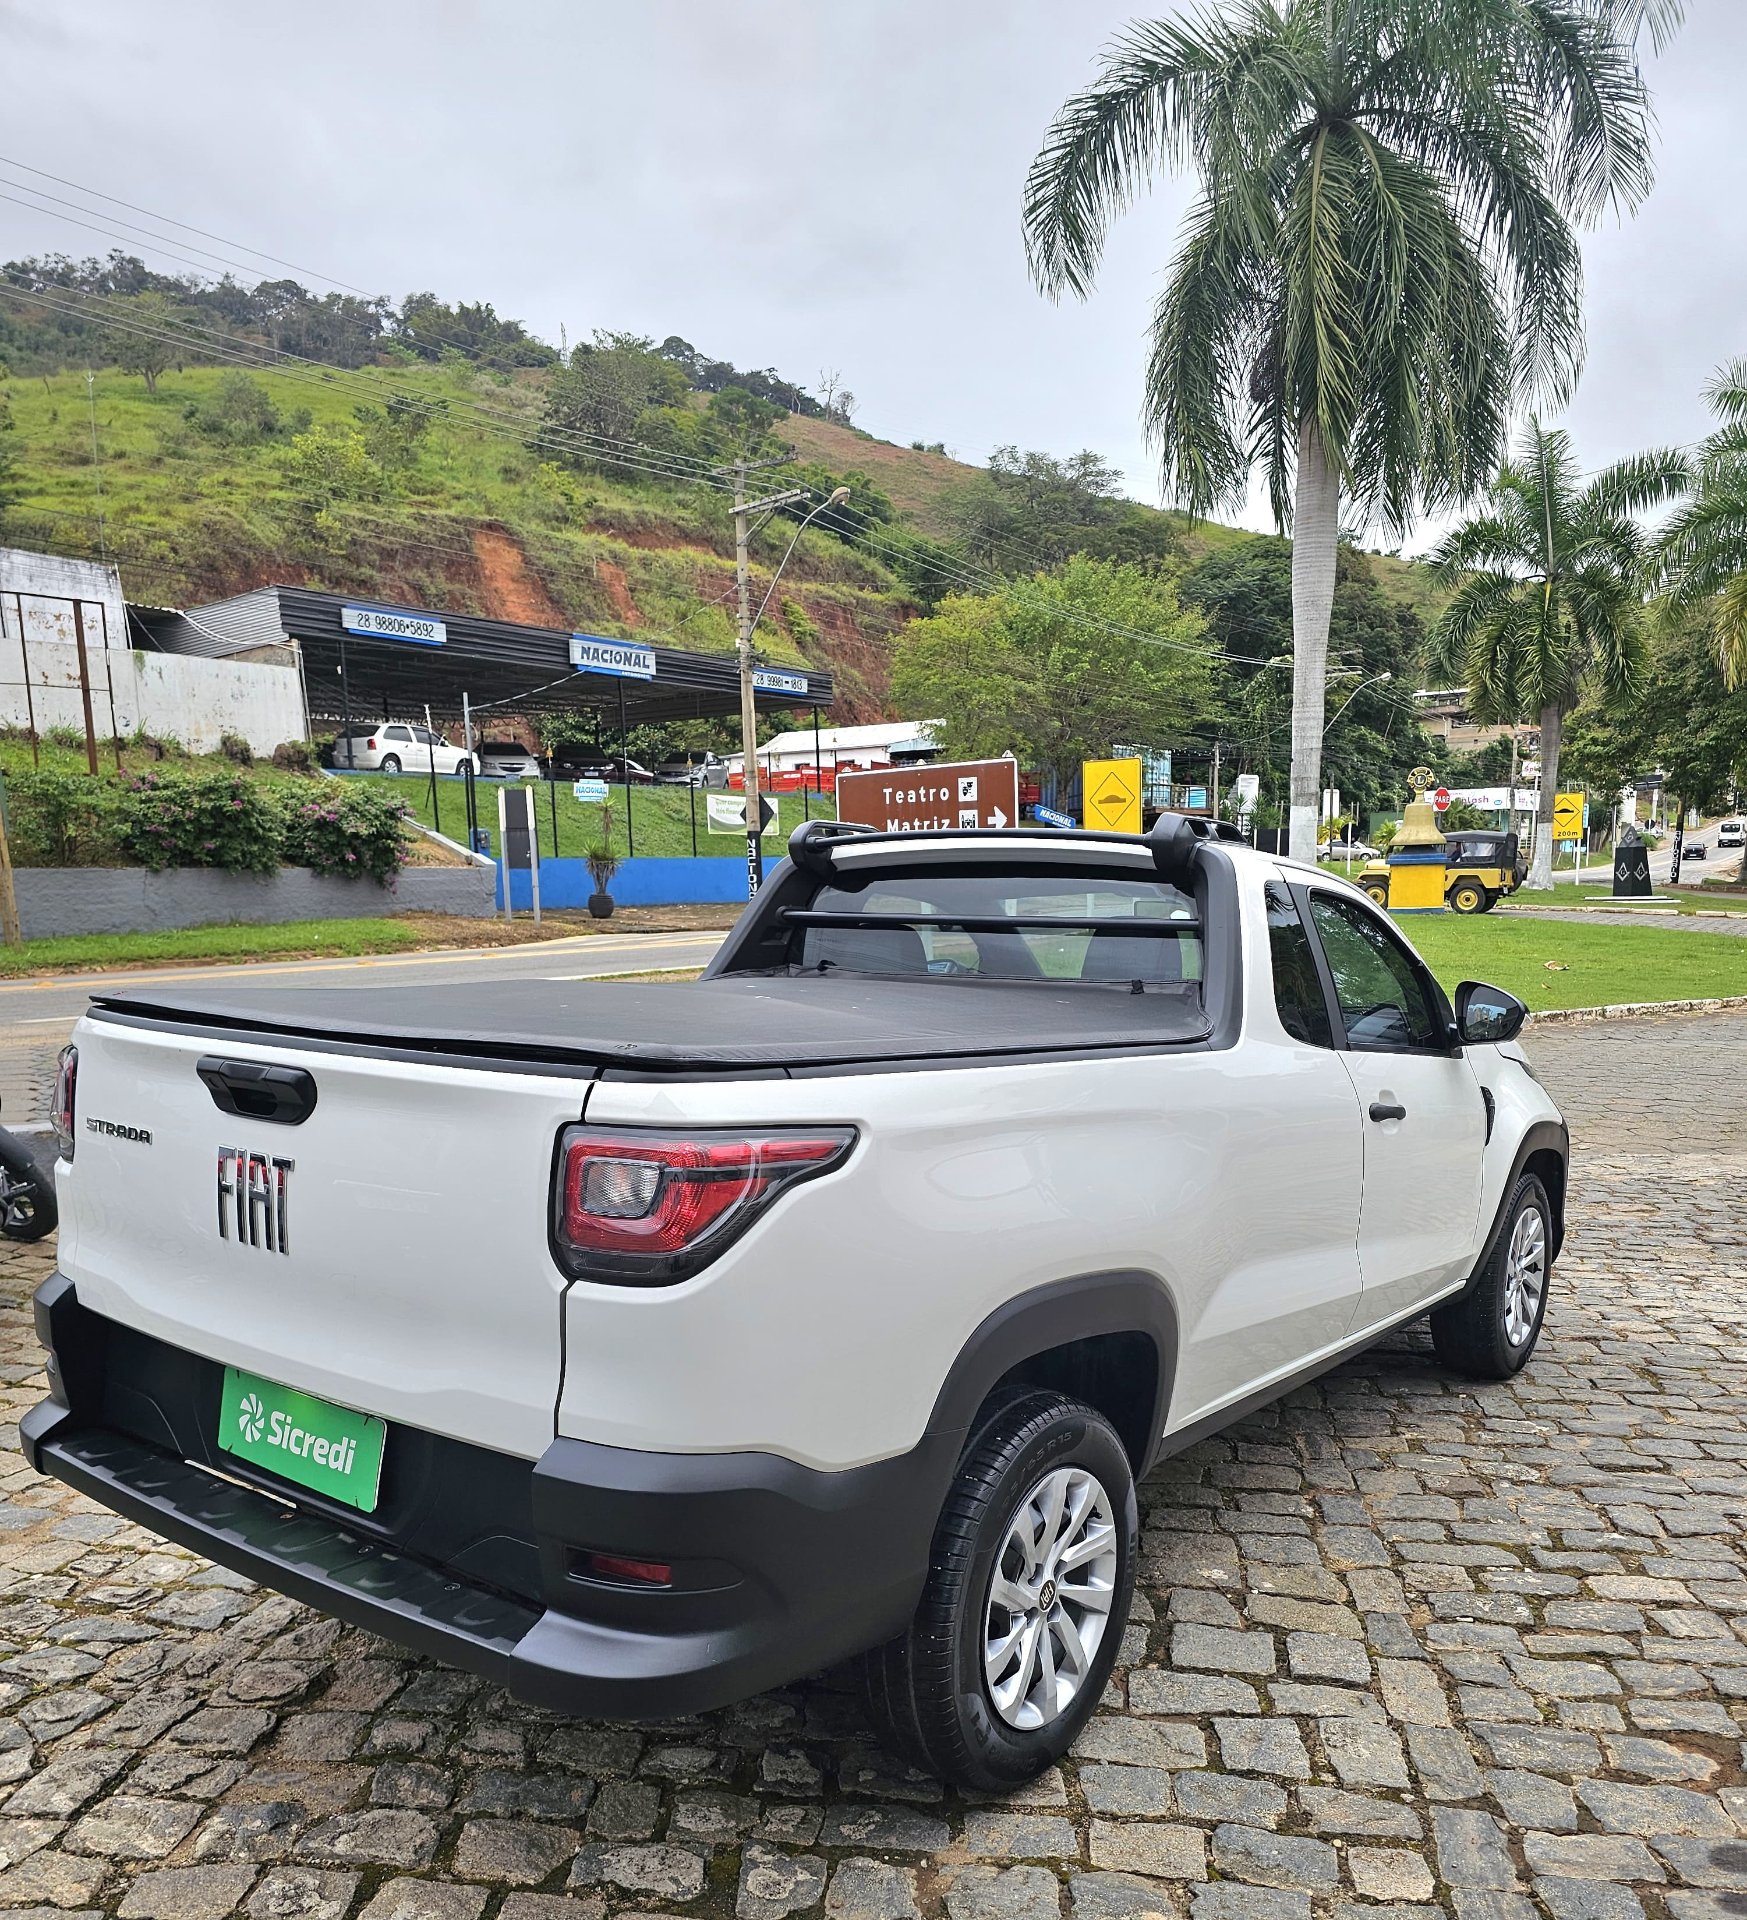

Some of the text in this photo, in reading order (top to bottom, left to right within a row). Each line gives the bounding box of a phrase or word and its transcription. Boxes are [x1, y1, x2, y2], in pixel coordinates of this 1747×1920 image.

[357, 613, 371, 628] 28
[580, 645, 650, 669] NACIONAL
[756, 673, 765, 685] 28
[575, 786, 607, 795] NACIONAL
[882, 785, 950, 805] Teatro
[1434, 795, 1451, 803] PARE
[886, 815, 951, 833] Matriz
[1040, 808, 1072, 827] NACIONAL
[86, 1117, 153, 1145] STRADA
[217, 1143, 295, 1256] FIAT
[267, 1410, 357, 1475] Sicredi
[1040, 1582, 1055, 1609] FIAT
